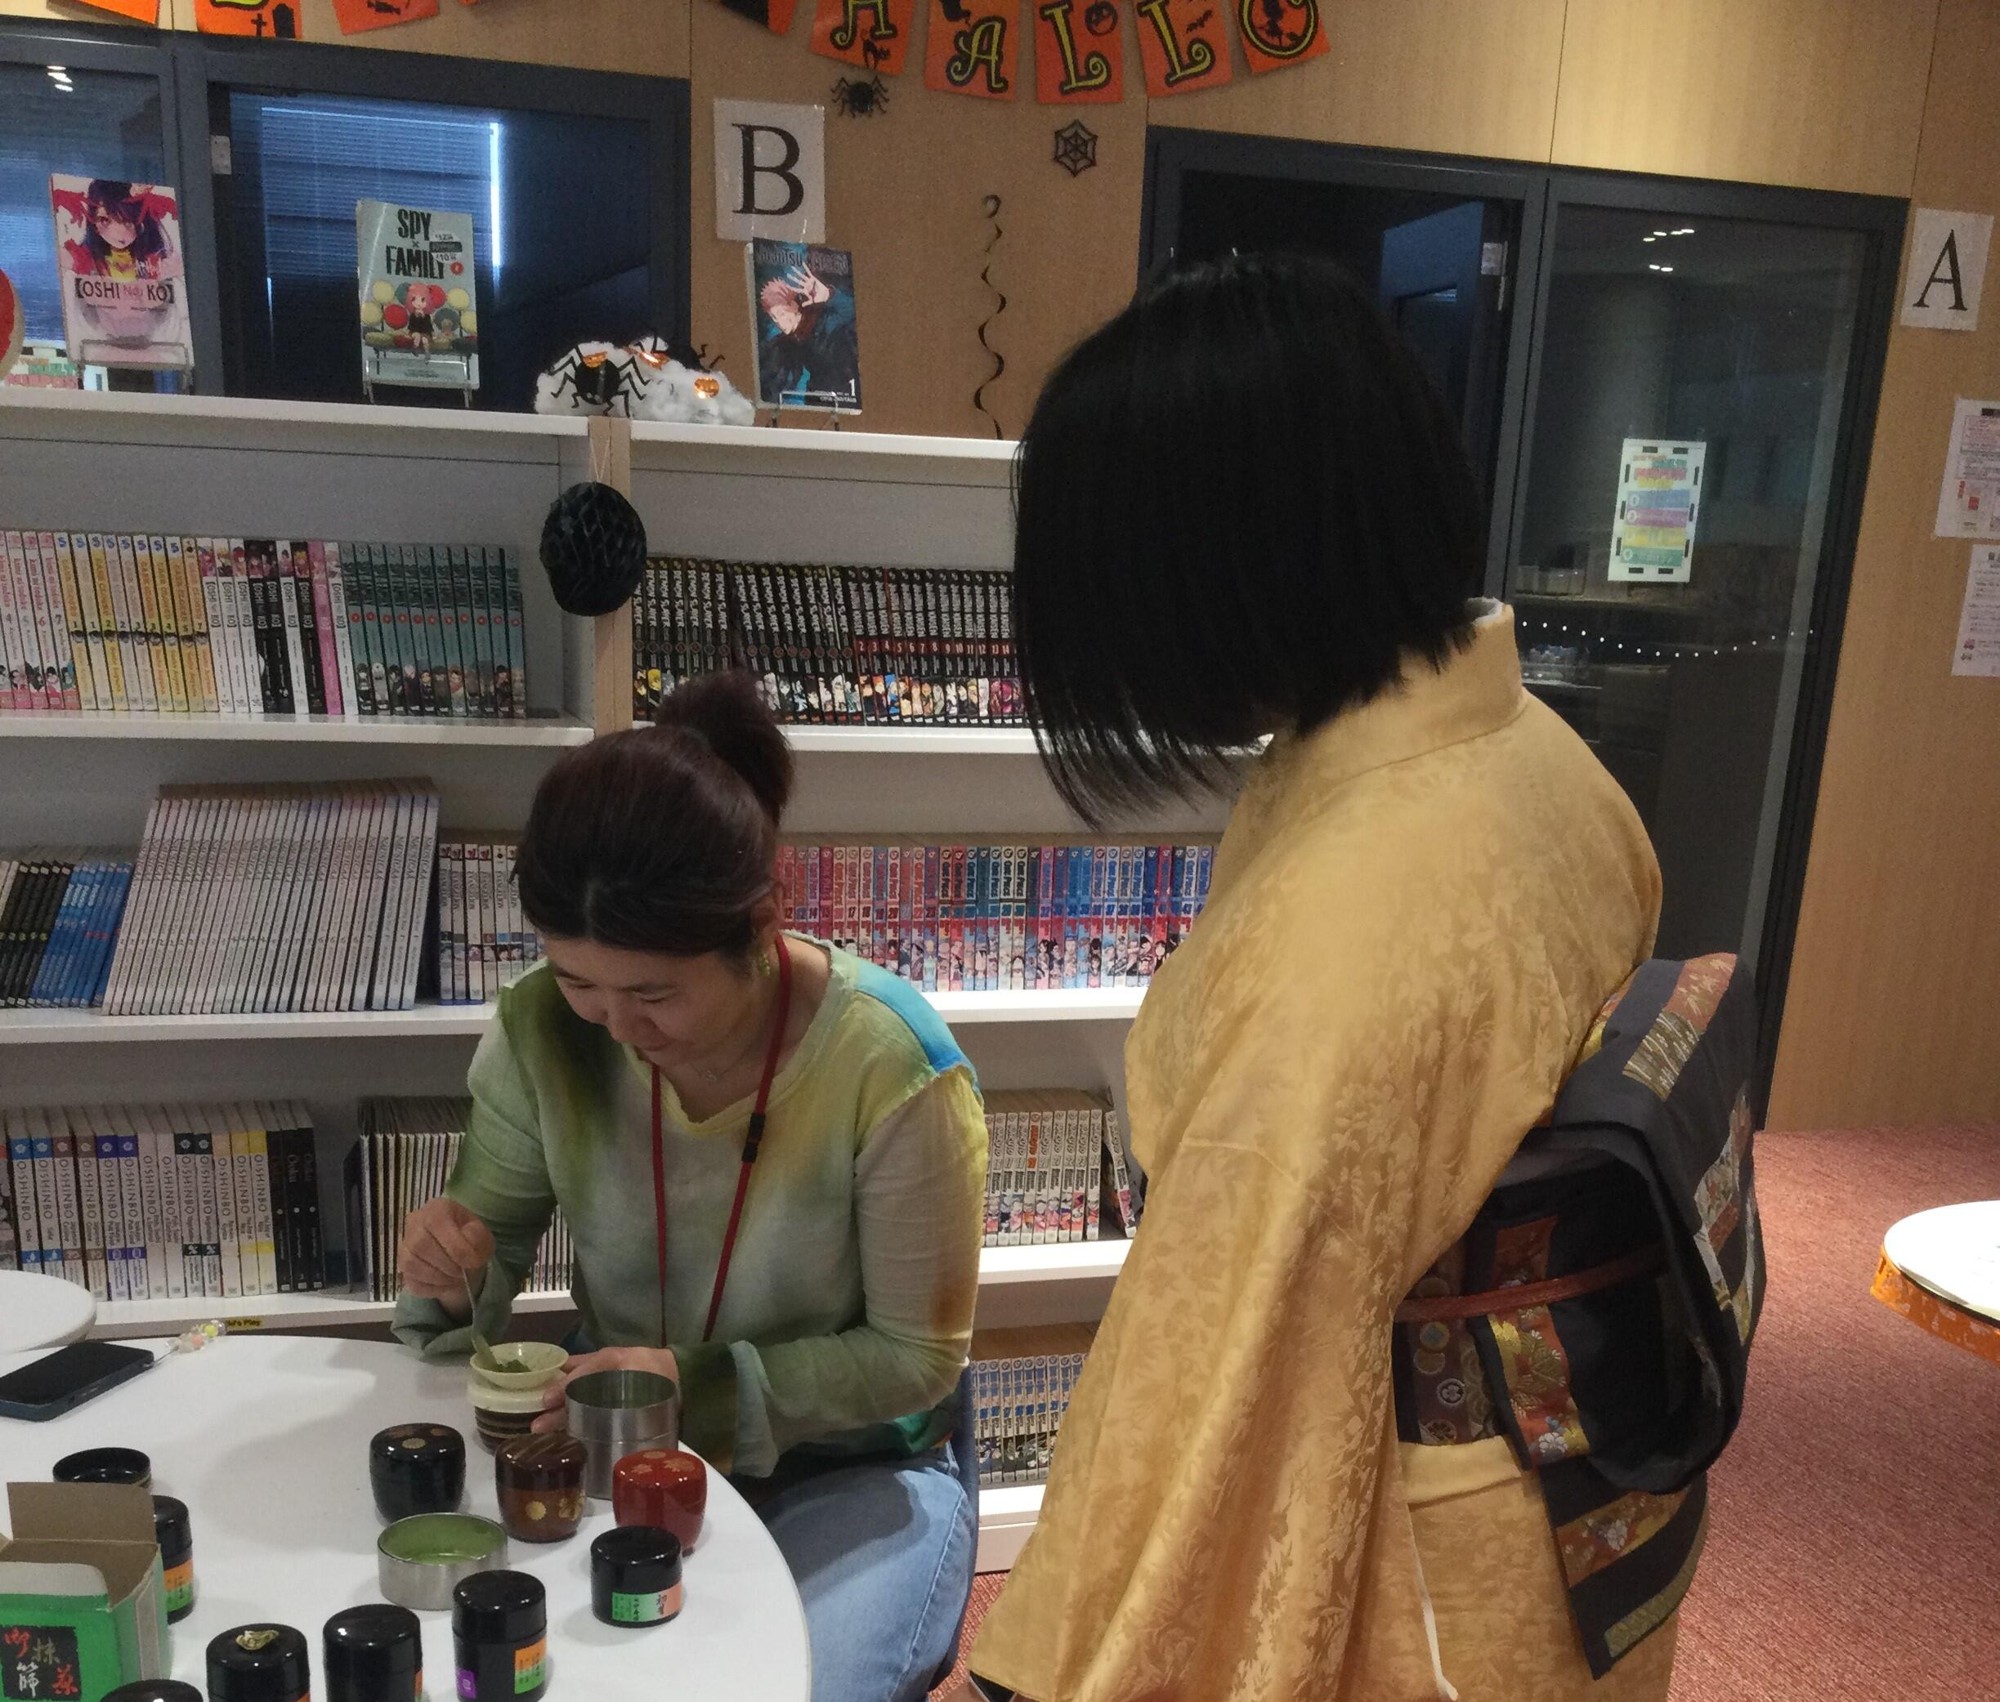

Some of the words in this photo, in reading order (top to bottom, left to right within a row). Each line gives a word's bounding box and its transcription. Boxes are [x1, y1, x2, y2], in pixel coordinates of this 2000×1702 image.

[731, 123, 804, 216] B
[397, 208, 432, 241] SPY
[385, 245, 445, 279] FAMILY
[1912, 229, 1968, 311] A
[849, 378, 857, 397] 1
[858, 641, 865, 651] 2
[872, 642, 878, 651] 3
[885, 640, 891, 650] 4
[909, 642, 915, 652] 6
[920, 643, 926, 653] 7
[932, 642, 938, 652] 8
[945, 643, 951, 653] 9
[955, 643, 964, 653] 10
[967, 643, 975, 654] 11
[978, 644, 987, 654] 12
[992, 644, 999, 654] 13
[1002, 644, 1010, 654] 14
[17, 1161, 32, 1221] OISHINBO
[38, 1159, 53, 1219] OISHINBO
[59, 1159, 74, 1218] OISHINBO
[82, 1159, 97, 1219] OISHINBO
[104, 1159, 118, 1219] OISHINBO
[125, 1158, 139, 1218] OISHINBO
[143, 1155, 157, 1215] OISHINBO
[162, 1156, 176, 1215] OISHINBO
[182, 1156, 195, 1215] OISHINBO
[200, 1155, 213, 1215] OISHINBO
[218, 1157, 231, 1217] OISHINBO
[237, 1155, 250, 1214] OISHINBO
[254, 1154, 267, 1212] OISHINBO
